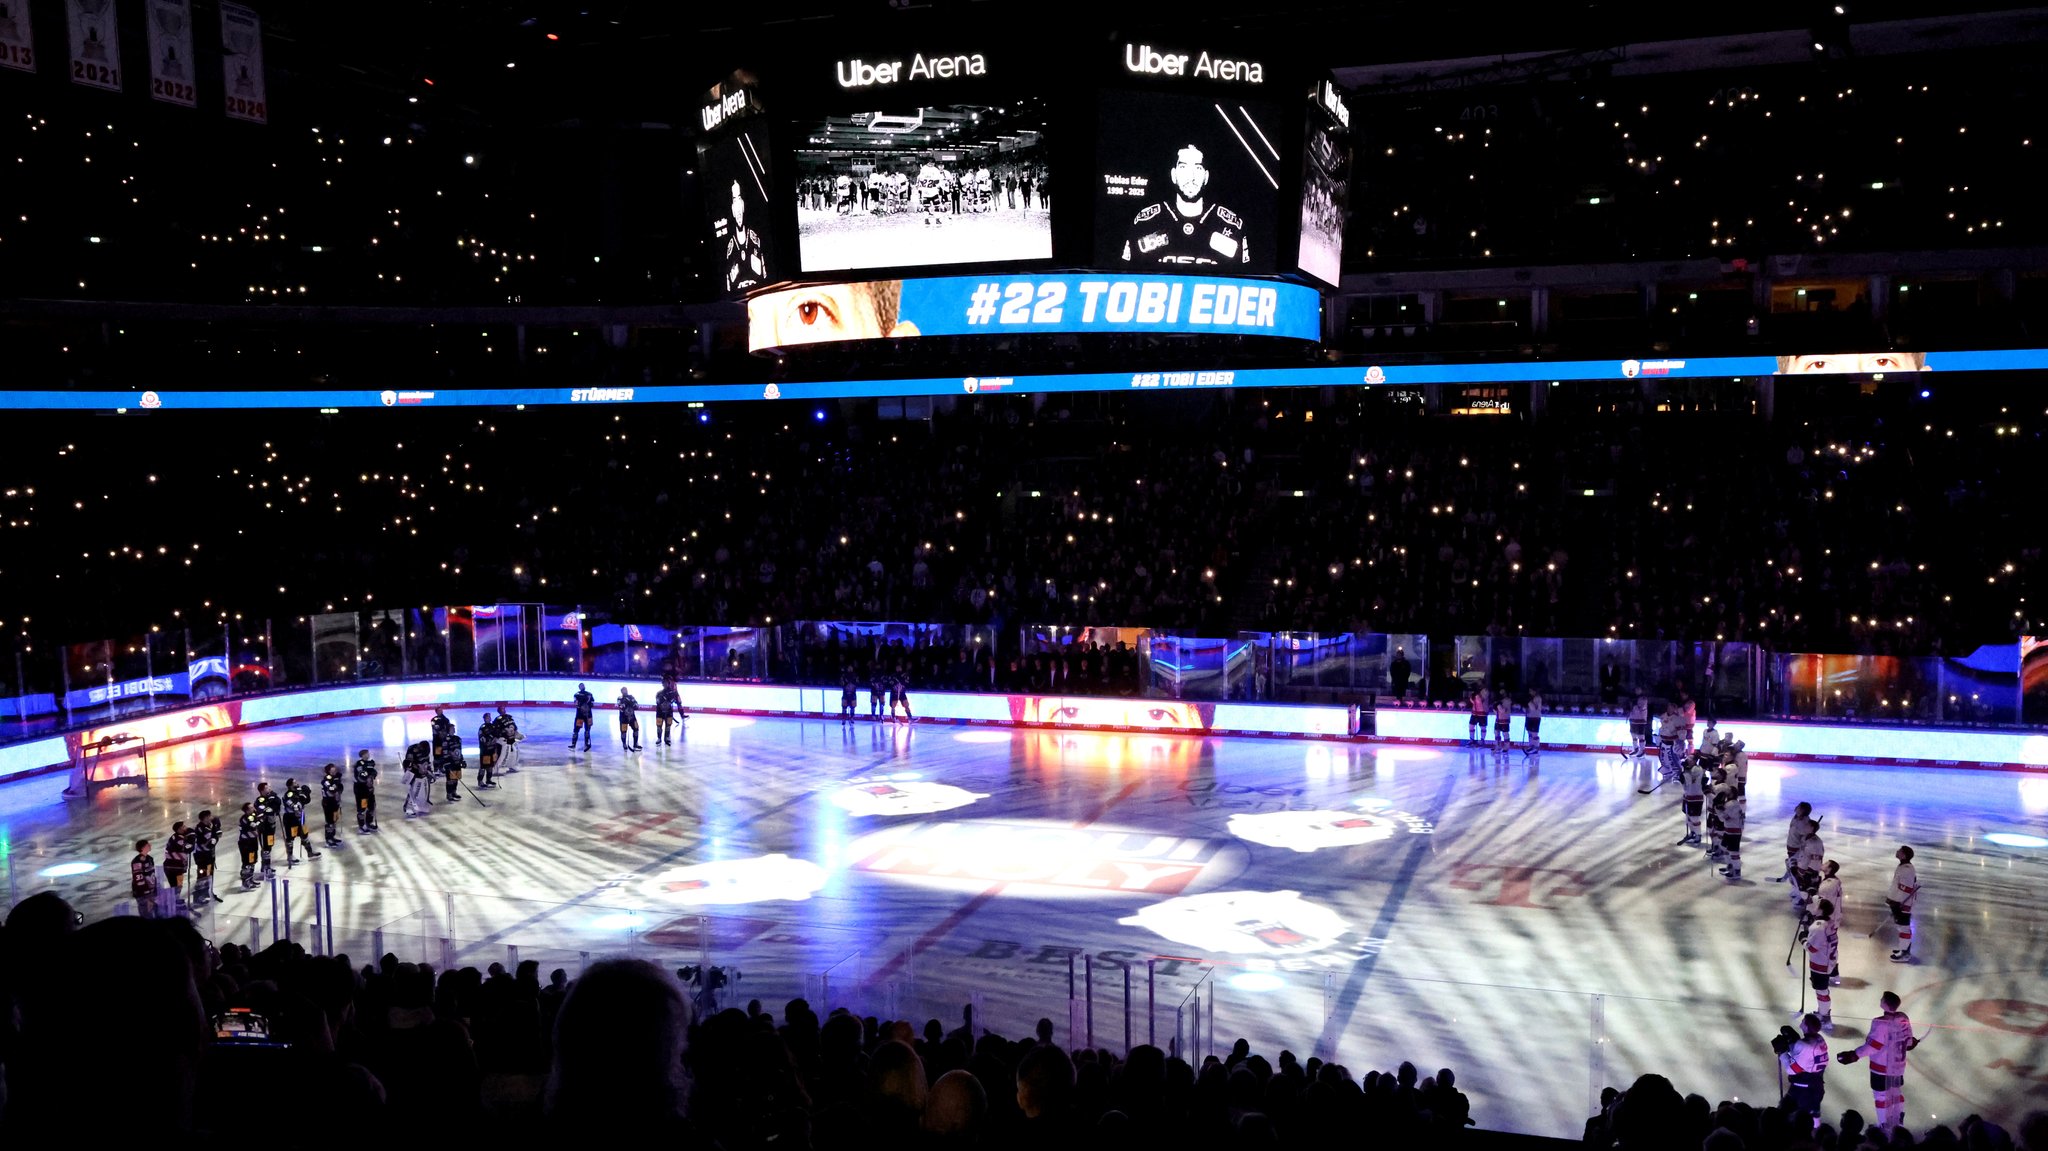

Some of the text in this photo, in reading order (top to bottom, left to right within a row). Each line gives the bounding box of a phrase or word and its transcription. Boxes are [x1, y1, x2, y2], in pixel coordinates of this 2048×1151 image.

[74, 60, 118, 86] 2021
[837, 53, 986, 87] Uber Arena
[1126, 44, 1263, 83] Uber Arena
[154, 78, 193, 100] 2022
[228, 96, 265, 118] 2024
[702, 89, 746, 131] Uber Arena
[1104, 174, 1148, 186] Tobias Eder
[1128, 187, 1145, 196] 2025
[967, 281, 1278, 327] #22 TOBI EDER
[1131, 371, 1235, 387] #22 TOBI EDER
[571, 387, 634, 401] STÜRMER
